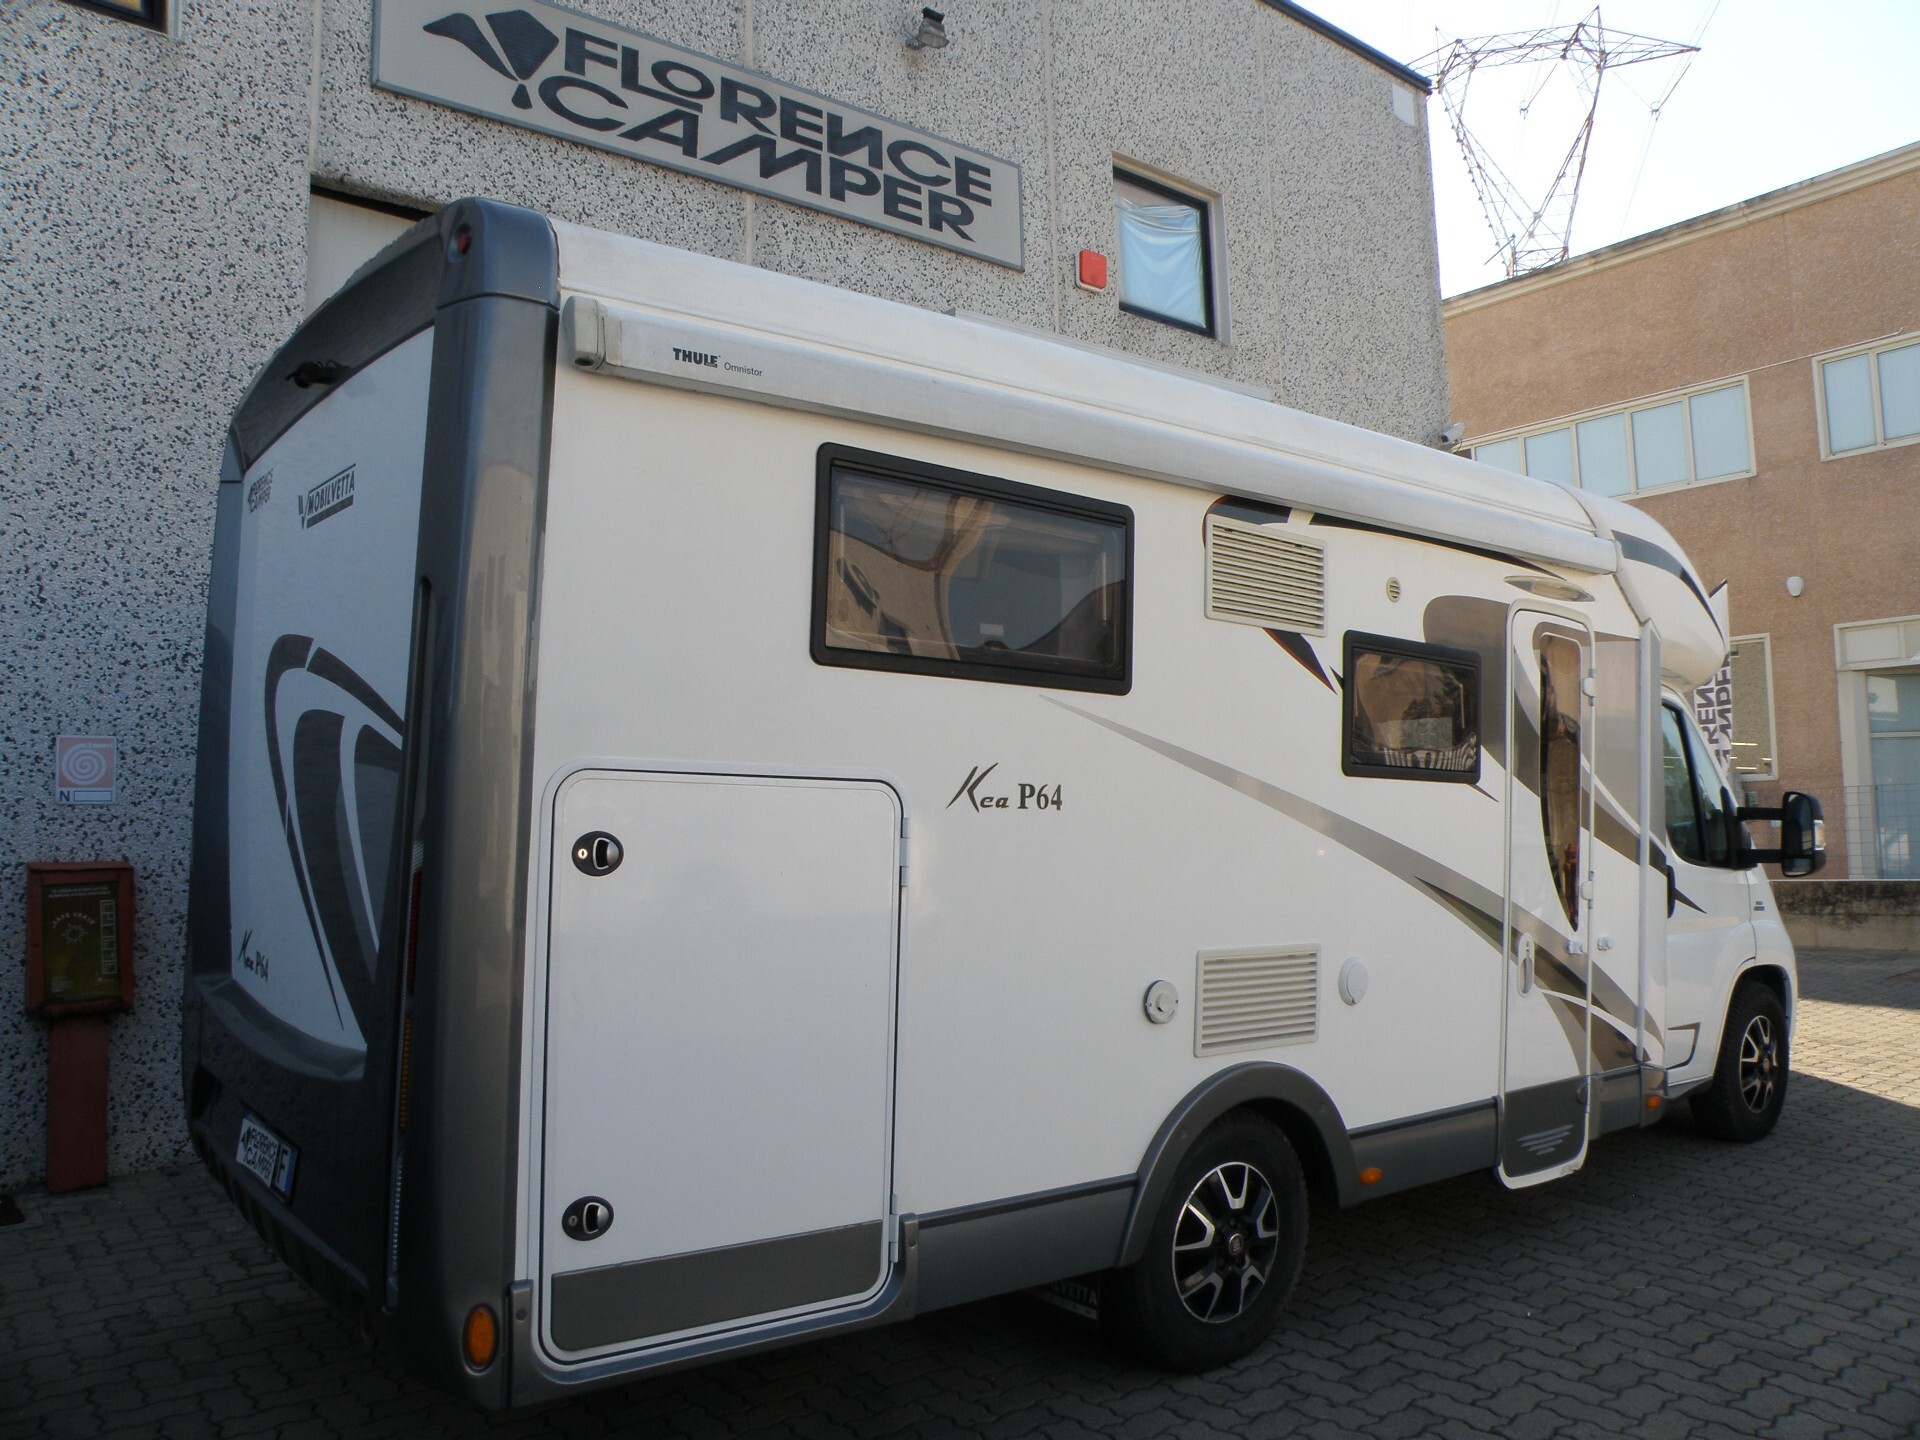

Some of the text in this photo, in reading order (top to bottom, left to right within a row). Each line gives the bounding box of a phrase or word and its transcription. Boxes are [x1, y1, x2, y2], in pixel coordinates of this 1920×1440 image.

[565, 27, 992, 206] FLORENCE
[538, 75, 975, 242] CAMPER
[673, 347, 763, 376] THULE Omnistor
[307, 469, 355, 516] MOBILVETTA
[59, 790, 71, 802] N
[945, 762, 1063, 813] Kea P64
[255, 950, 270, 984] P64
